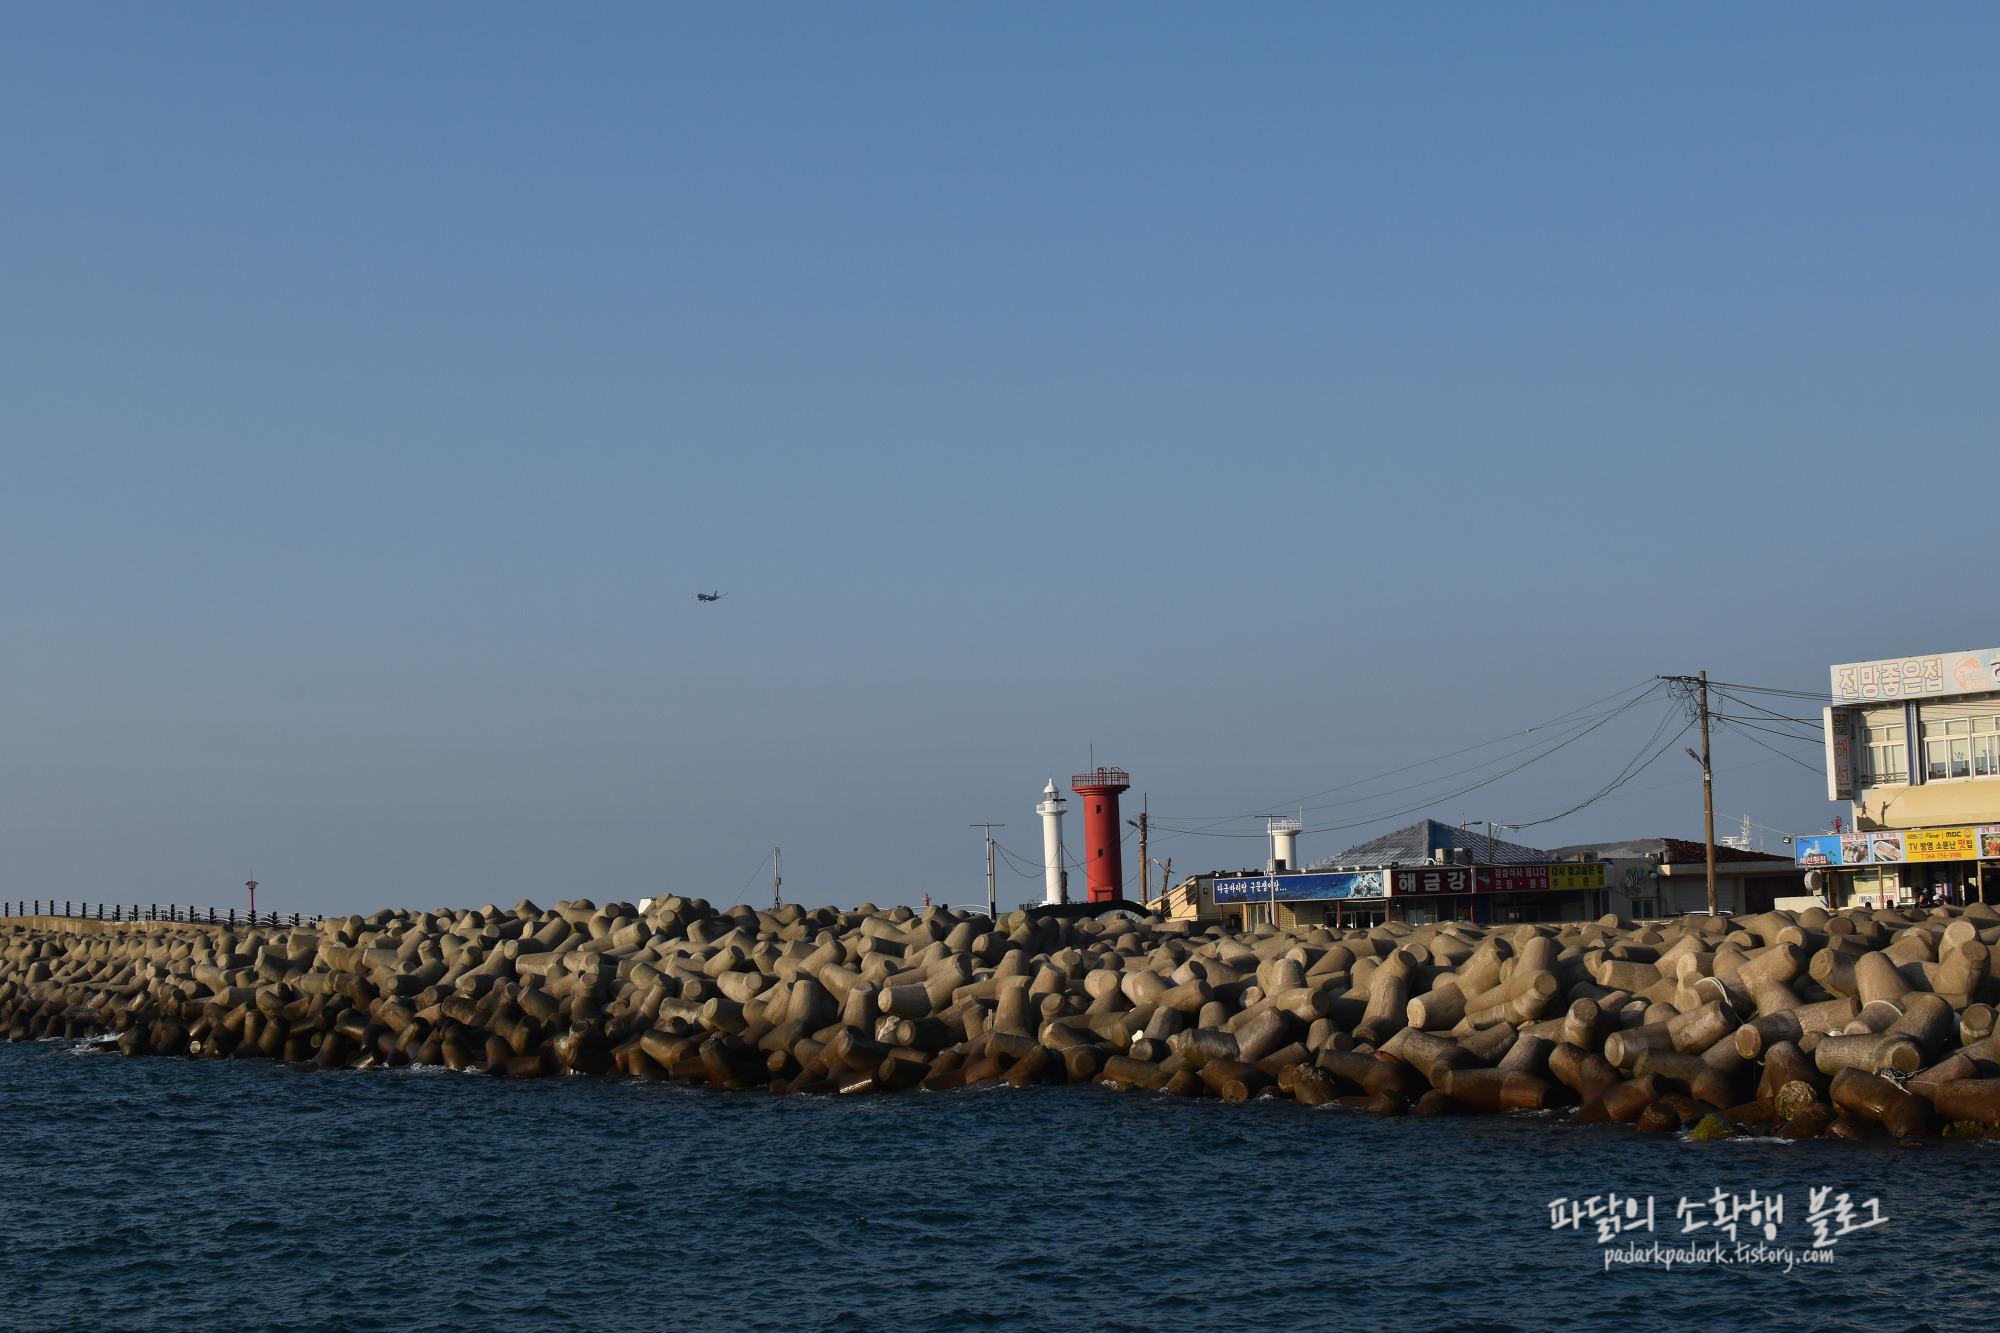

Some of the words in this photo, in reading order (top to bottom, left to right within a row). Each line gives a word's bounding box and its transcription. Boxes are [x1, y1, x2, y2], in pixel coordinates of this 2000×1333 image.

[1839, 658, 1944, 699] 전망좋은집
[1920, 841, 1933, 851] 방영
[1936, 840, 1956, 850] 소문난
[1958, 838, 1973, 849] 맛집
[1217, 881, 1247, 894] 다금바리랑
[1398, 871, 1466, 893] 해금강
